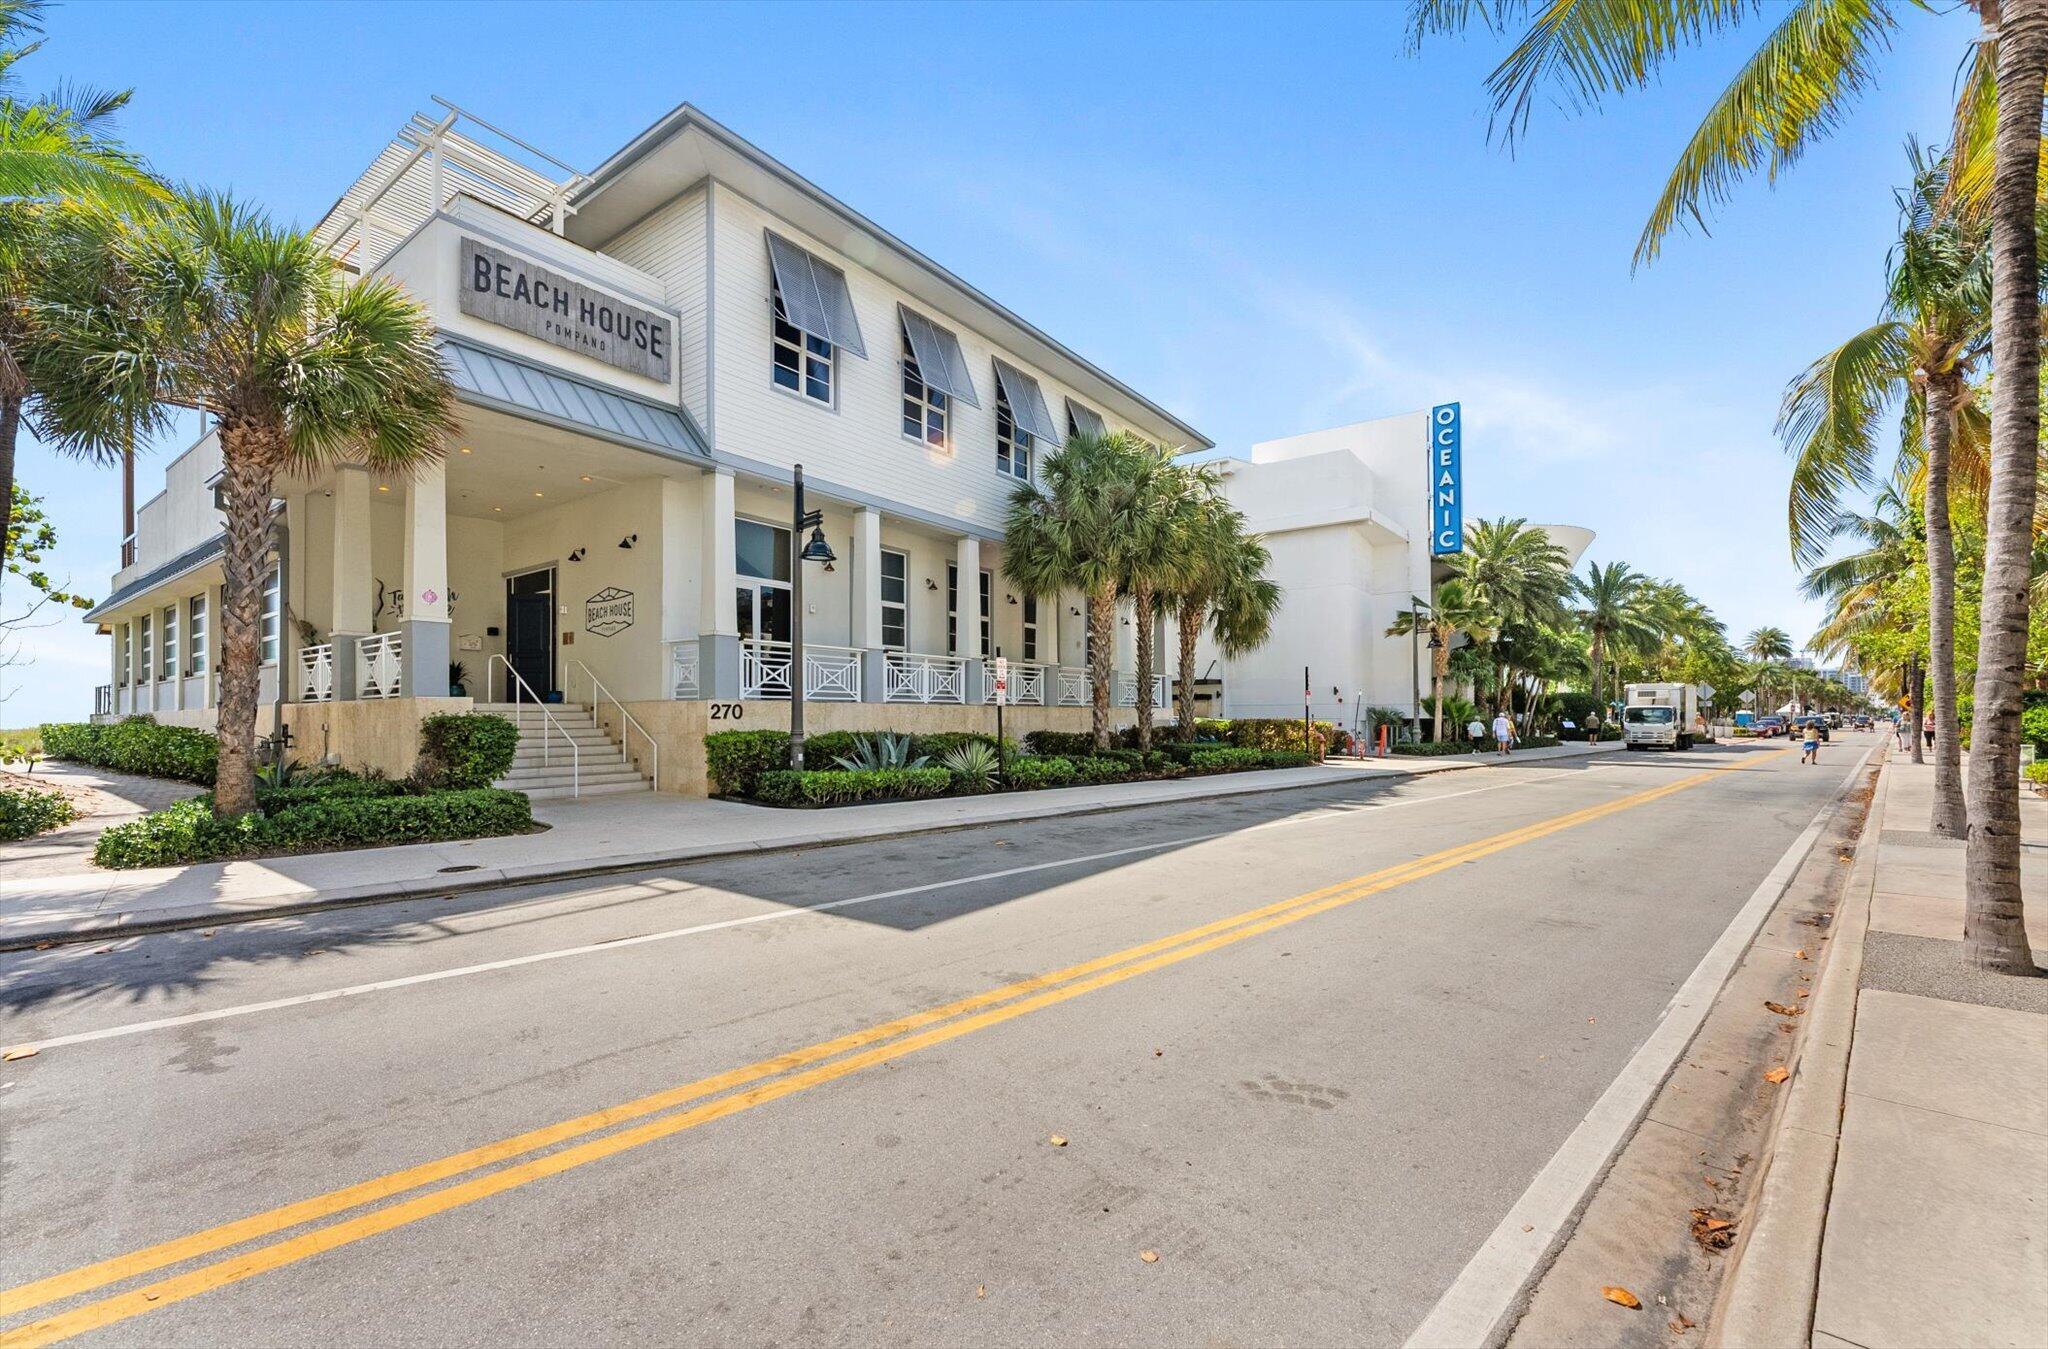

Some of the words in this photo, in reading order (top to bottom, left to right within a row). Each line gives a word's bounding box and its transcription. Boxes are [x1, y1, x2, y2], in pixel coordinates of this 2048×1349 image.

[474, 253, 569, 317] BEACH
[580, 298, 663, 359] HOUSE
[545, 320, 606, 351] POMPANO
[1436, 407, 1455, 547] OCEANIC
[588, 605, 609, 623] BEACH
[609, 601, 632, 617] HOUSE
[710, 703, 744, 720] 270
